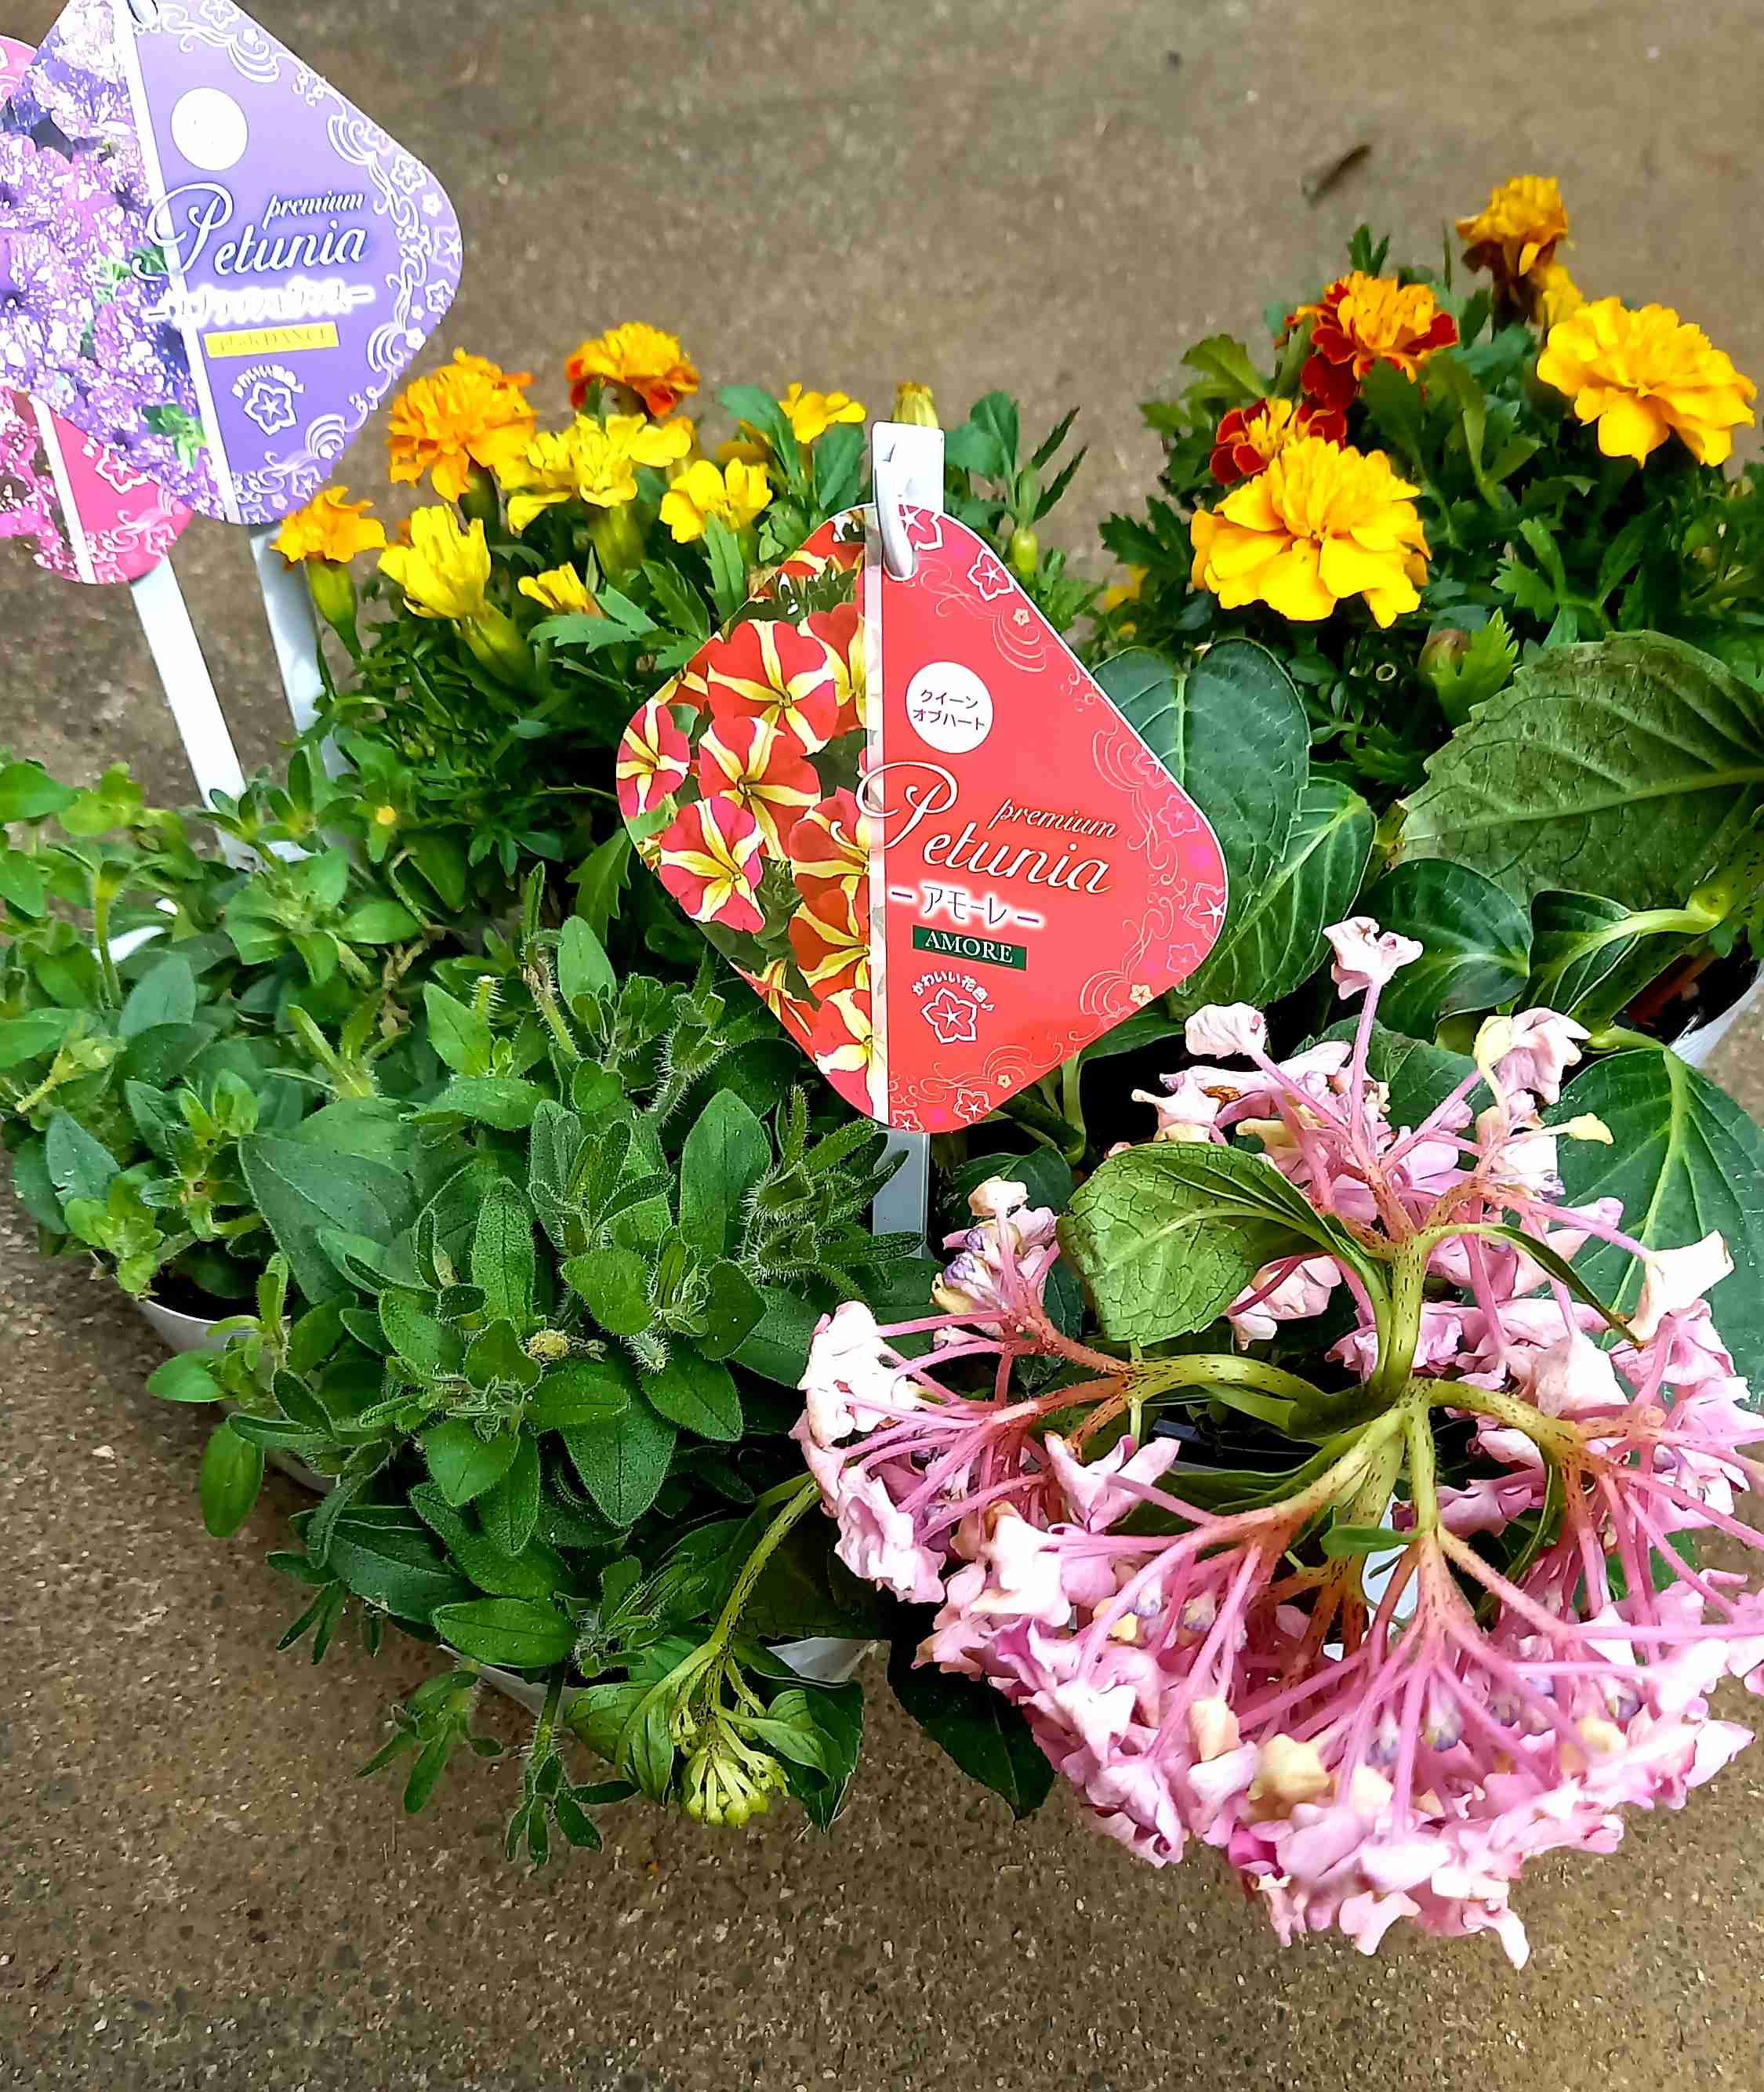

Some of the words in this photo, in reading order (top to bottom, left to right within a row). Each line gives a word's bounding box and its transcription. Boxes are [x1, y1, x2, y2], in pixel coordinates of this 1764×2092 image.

[261, 188, 365, 231] premium
[131, 182, 367, 281] Petunia
[920, 688, 978, 709] クイーン
[913, 708, 985, 731] オブハート
[829, 761, 1112, 895] Petunia
[987, 797, 1120, 838] premium
[924, 930, 1014, 964] AMORE
